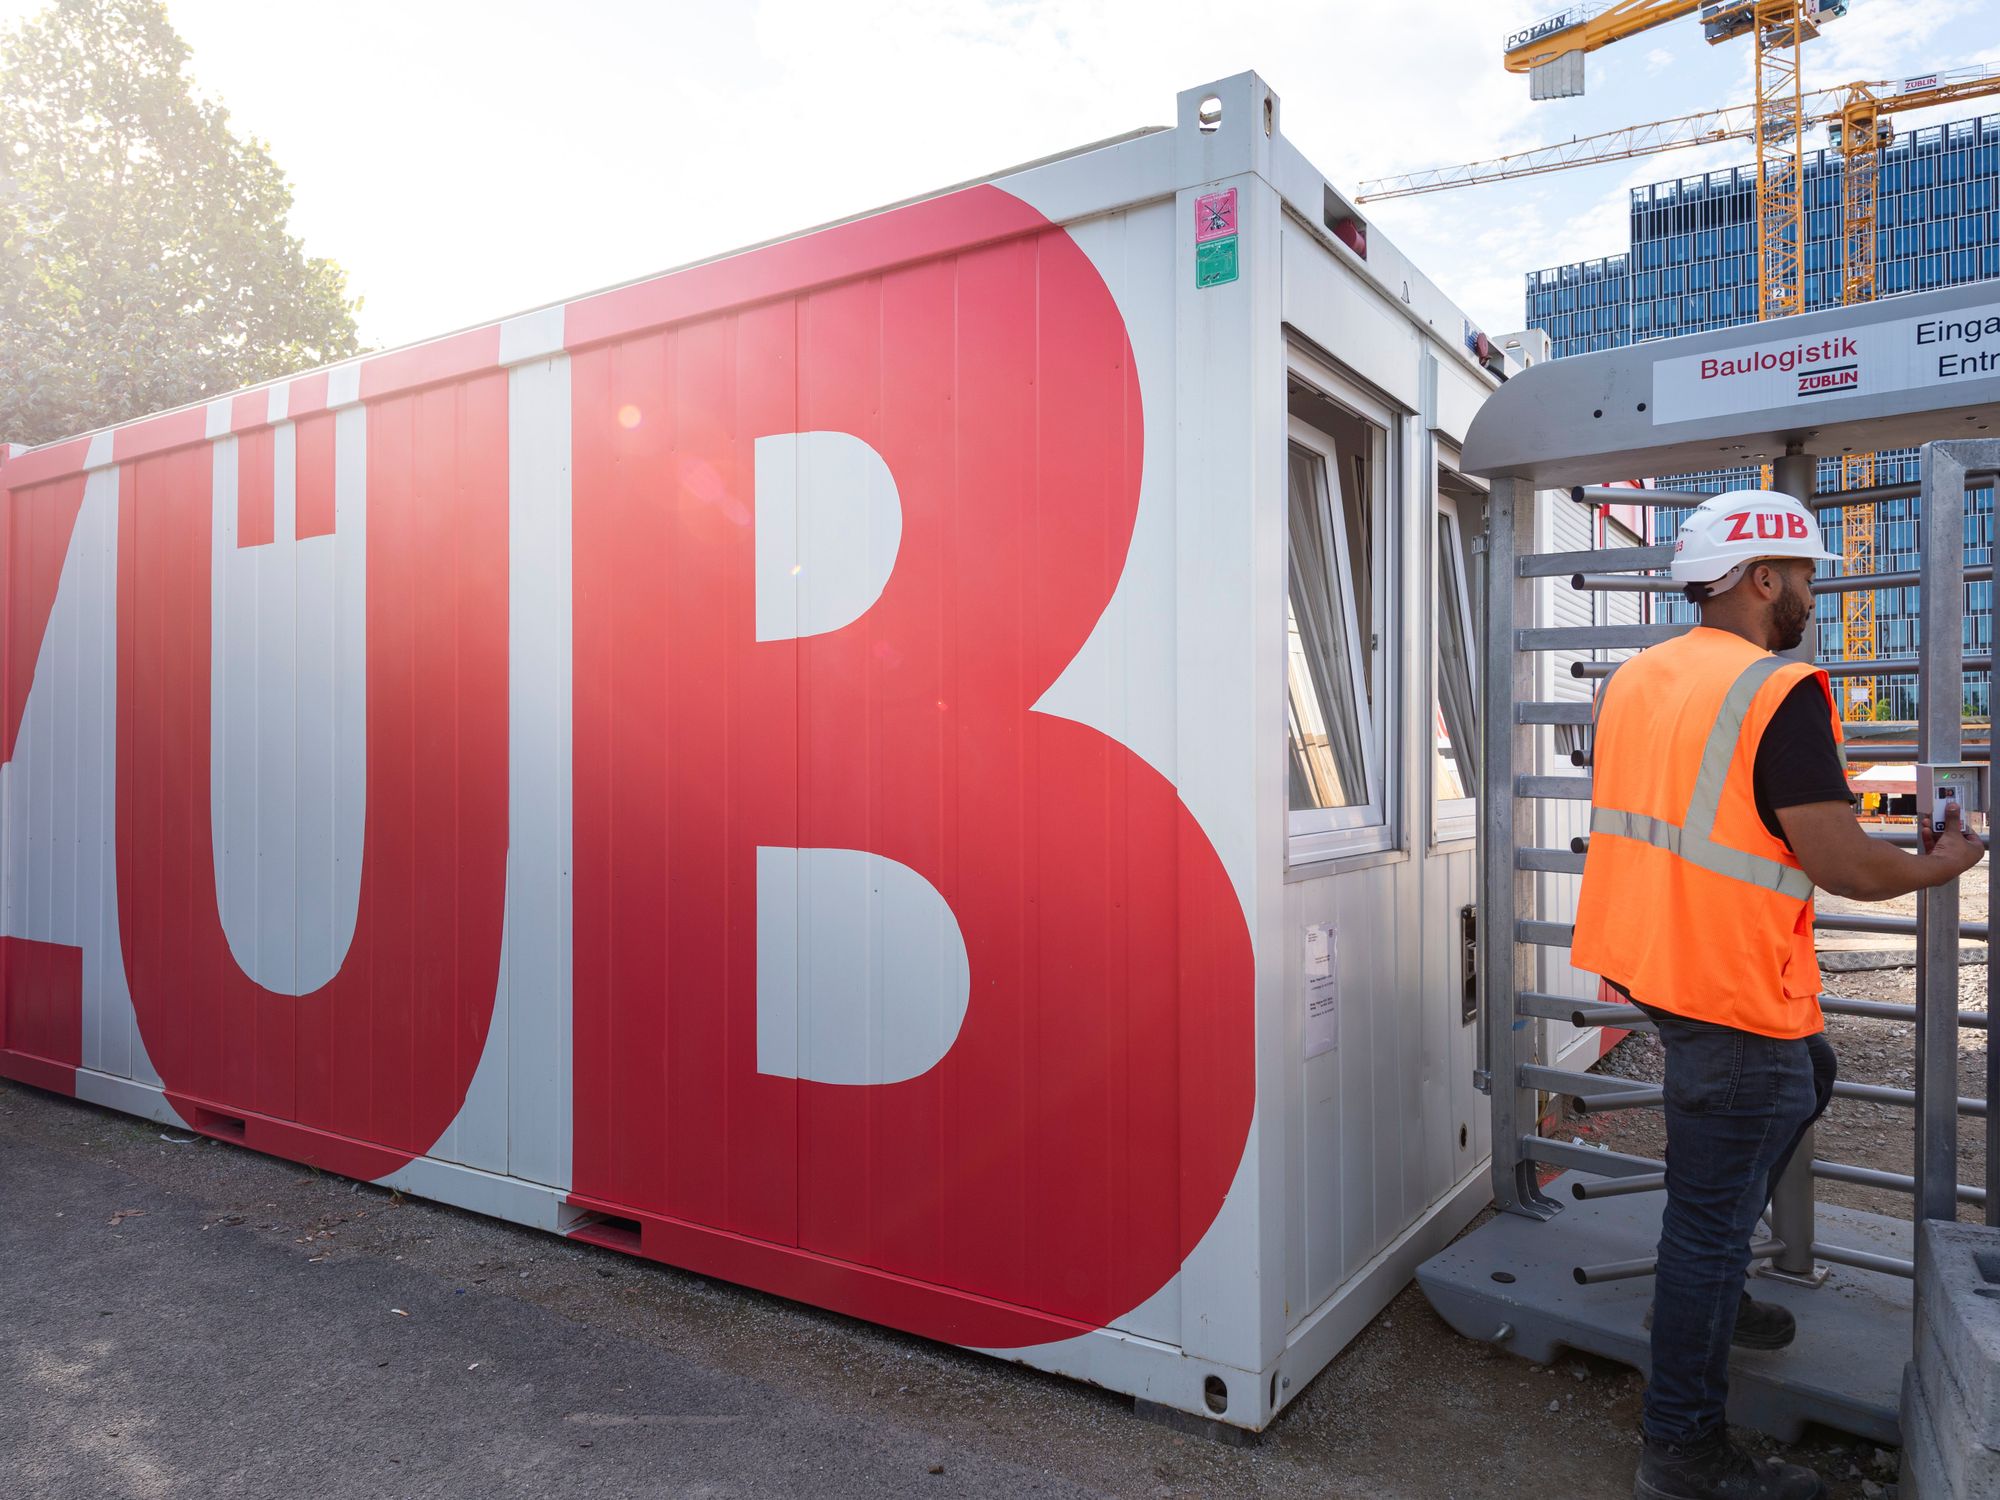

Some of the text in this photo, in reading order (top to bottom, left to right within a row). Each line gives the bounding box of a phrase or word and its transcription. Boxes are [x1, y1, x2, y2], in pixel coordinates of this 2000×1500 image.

[1507, 14, 1567, 48] POTAIN
[1904, 77, 1938, 90] ZÜBLIN
[1775, 288, 1783, 298] 2
[1916, 316, 2000, 346] Einga
[1701, 336, 1858, 380] Baulogistik
[1938, 350, 2000, 378] Entr
[1798, 369, 1859, 392] ZÜBLIN
[1724, 511, 1809, 542] ZÜB
